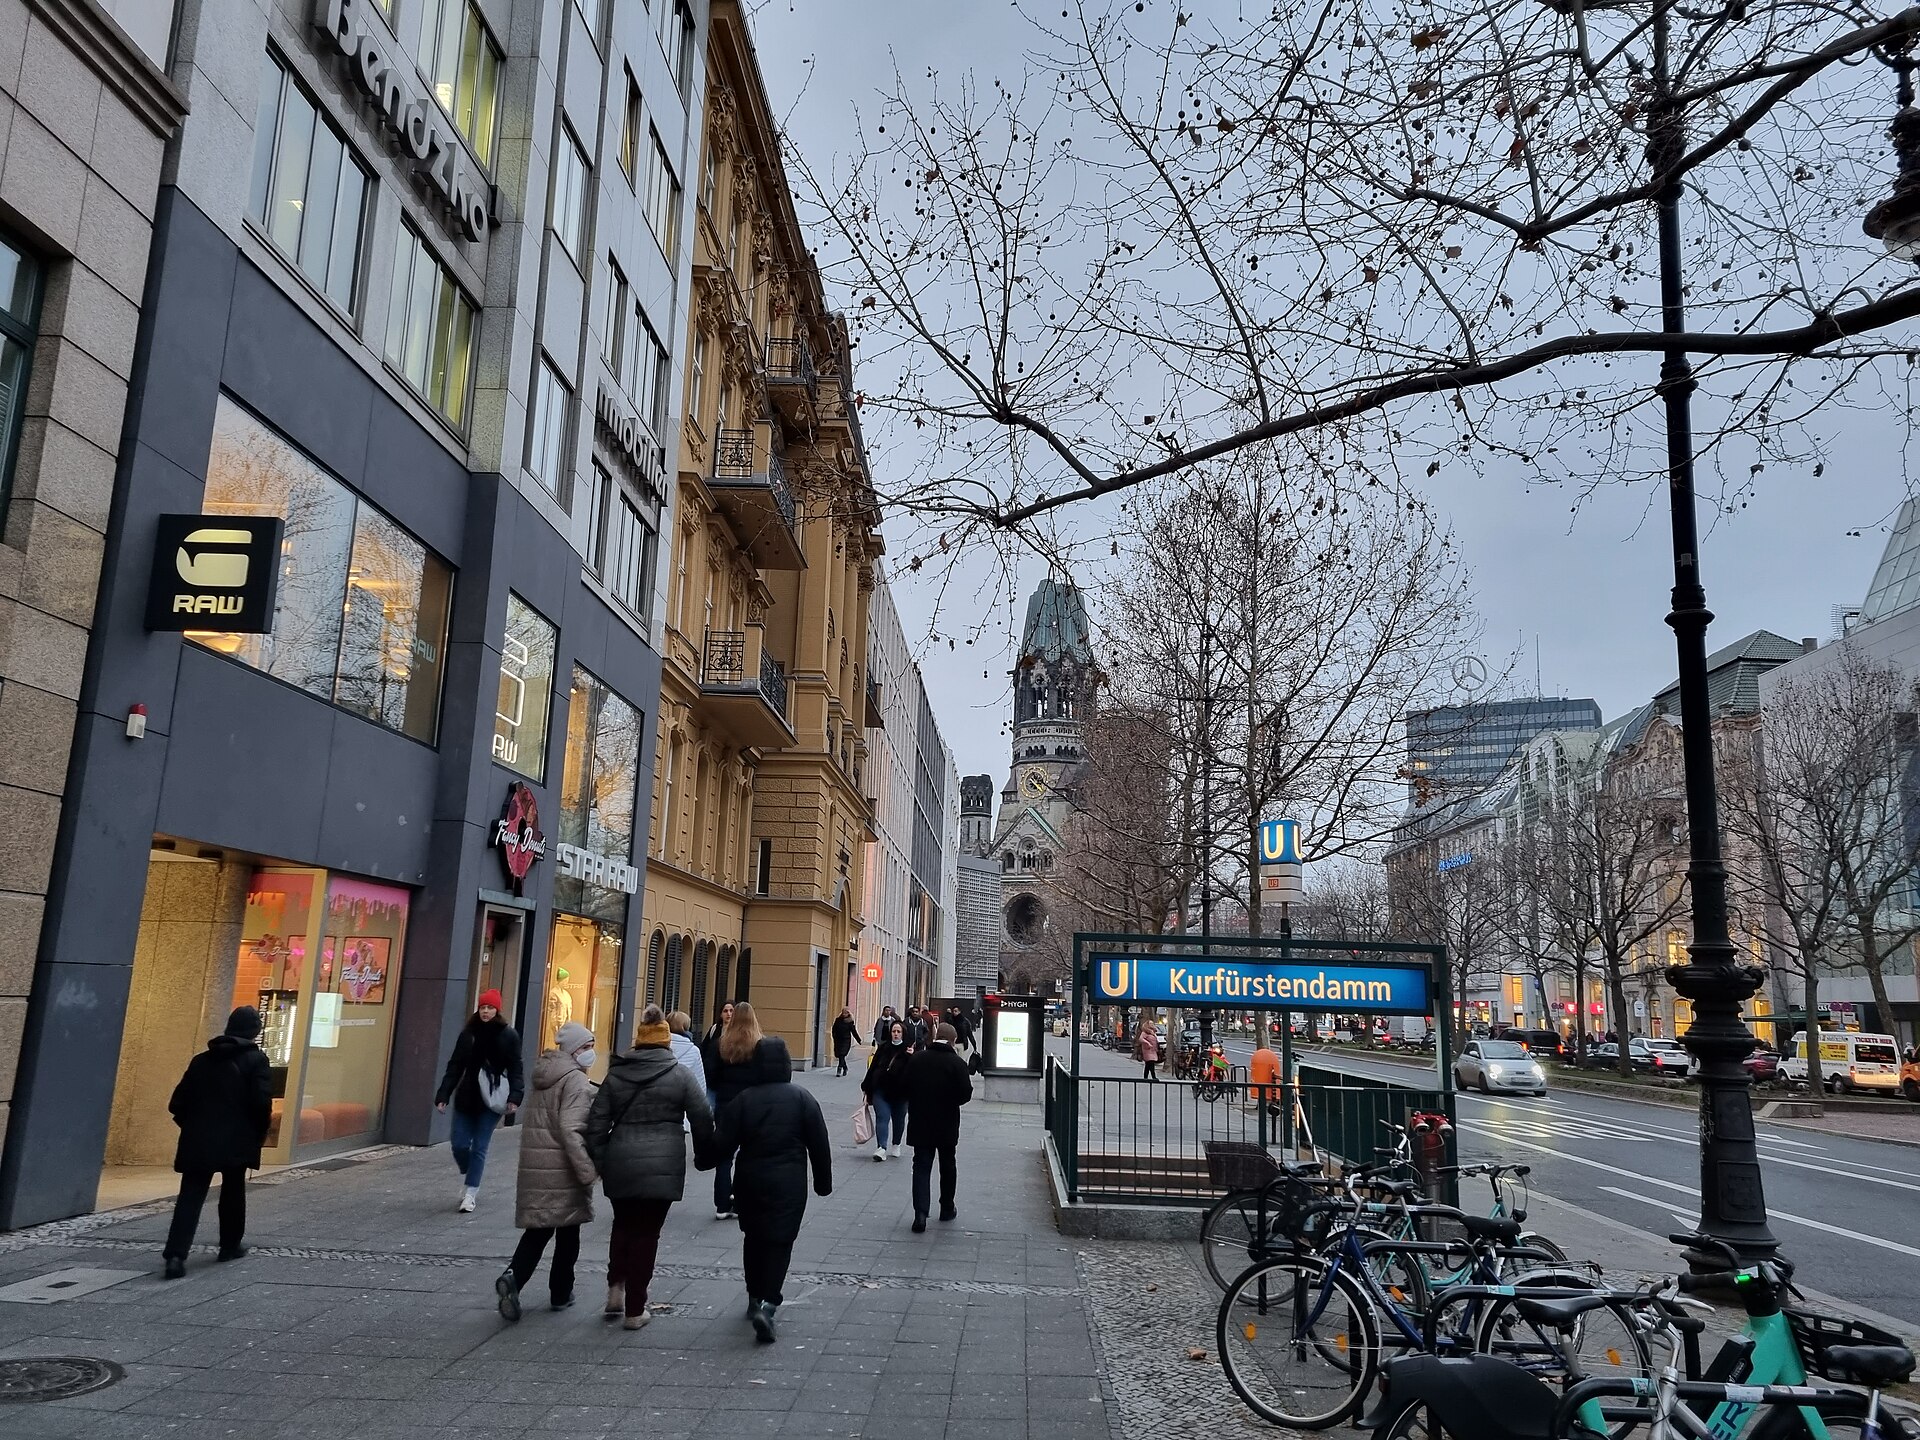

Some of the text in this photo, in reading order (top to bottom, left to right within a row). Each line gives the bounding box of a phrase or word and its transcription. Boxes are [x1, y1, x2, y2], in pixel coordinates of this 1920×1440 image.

[320, 0, 489, 242] Bendzko
[172, 594, 244, 615] RAW
[495, 819, 547, 854] Fancy Donuts
[1263, 824, 1284, 859] U
[608, 856, 639, 895] RAW
[1269, 879, 1278, 887] U9
[1100, 961, 1391, 1001] U Kurfürstendamm
